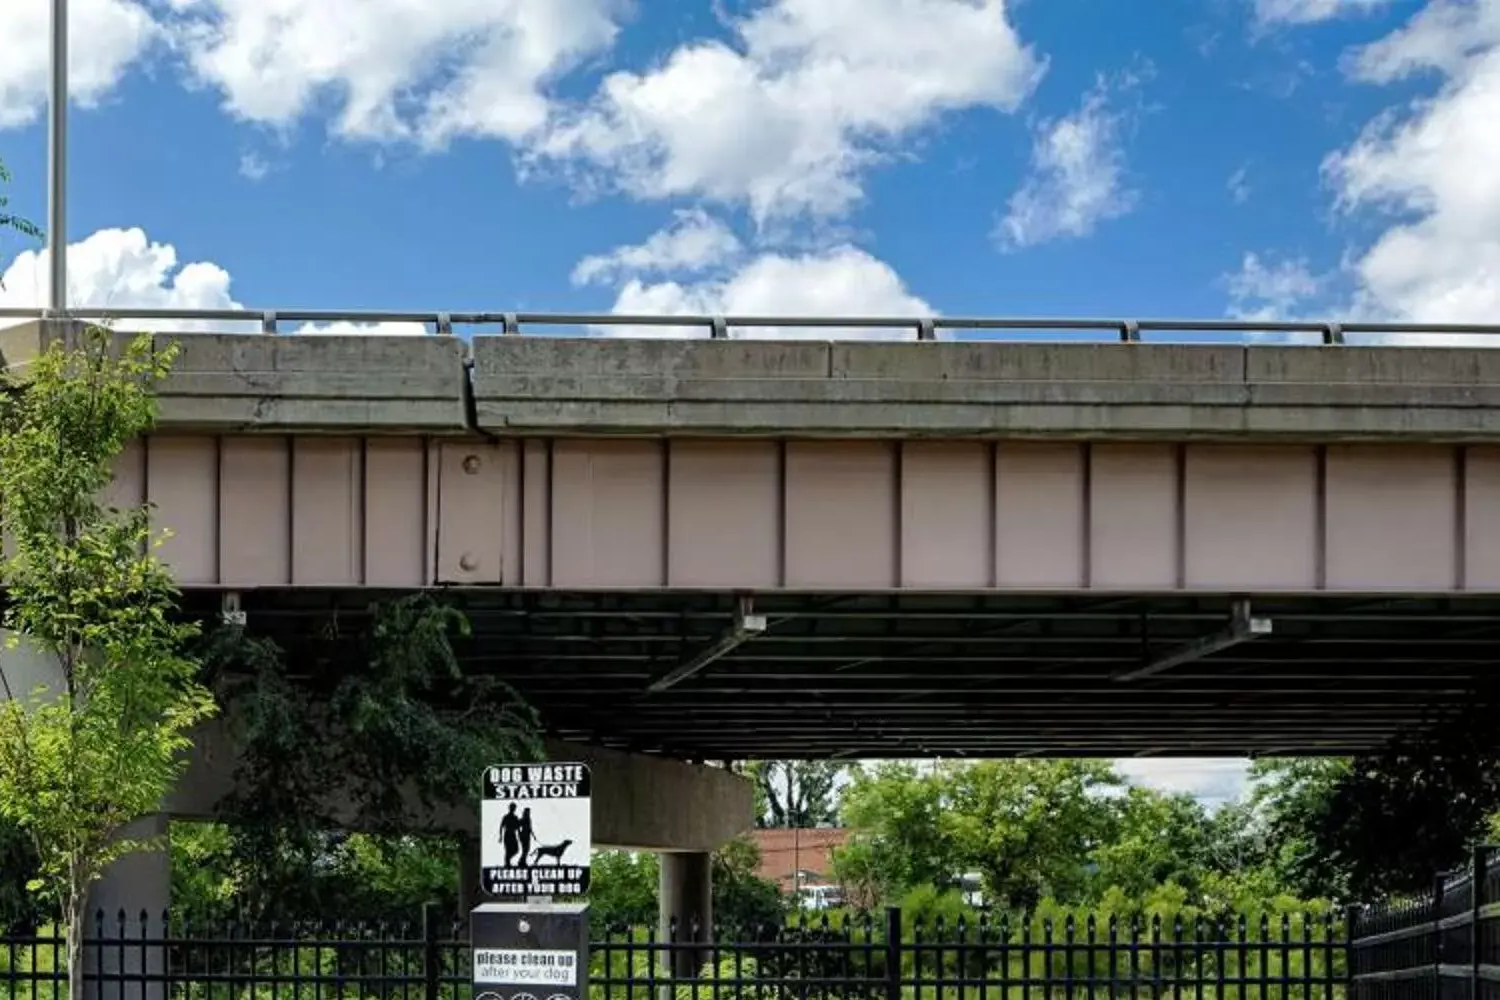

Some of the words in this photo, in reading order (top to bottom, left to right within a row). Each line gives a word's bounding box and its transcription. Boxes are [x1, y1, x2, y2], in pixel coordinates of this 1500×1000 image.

[490, 767, 522, 783] DOG
[527, 765, 583, 781] WASTE
[495, 784, 577, 799] STATION
[490, 869, 528, 880] PLEASE
[531, 869, 564, 880] CLEAN
[567, 868, 582, 879] UP
[492, 883, 524, 893] AFTER
[527, 883, 555, 893] YOUR
[558, 883, 581, 893] DOG
[477, 952, 517, 965] please
[521, 952, 555, 966] clean
[557, 955, 574, 967] up
[481, 966, 509, 978] after
[512, 968, 541, 981] your
[543, 967, 570, 981] dog
